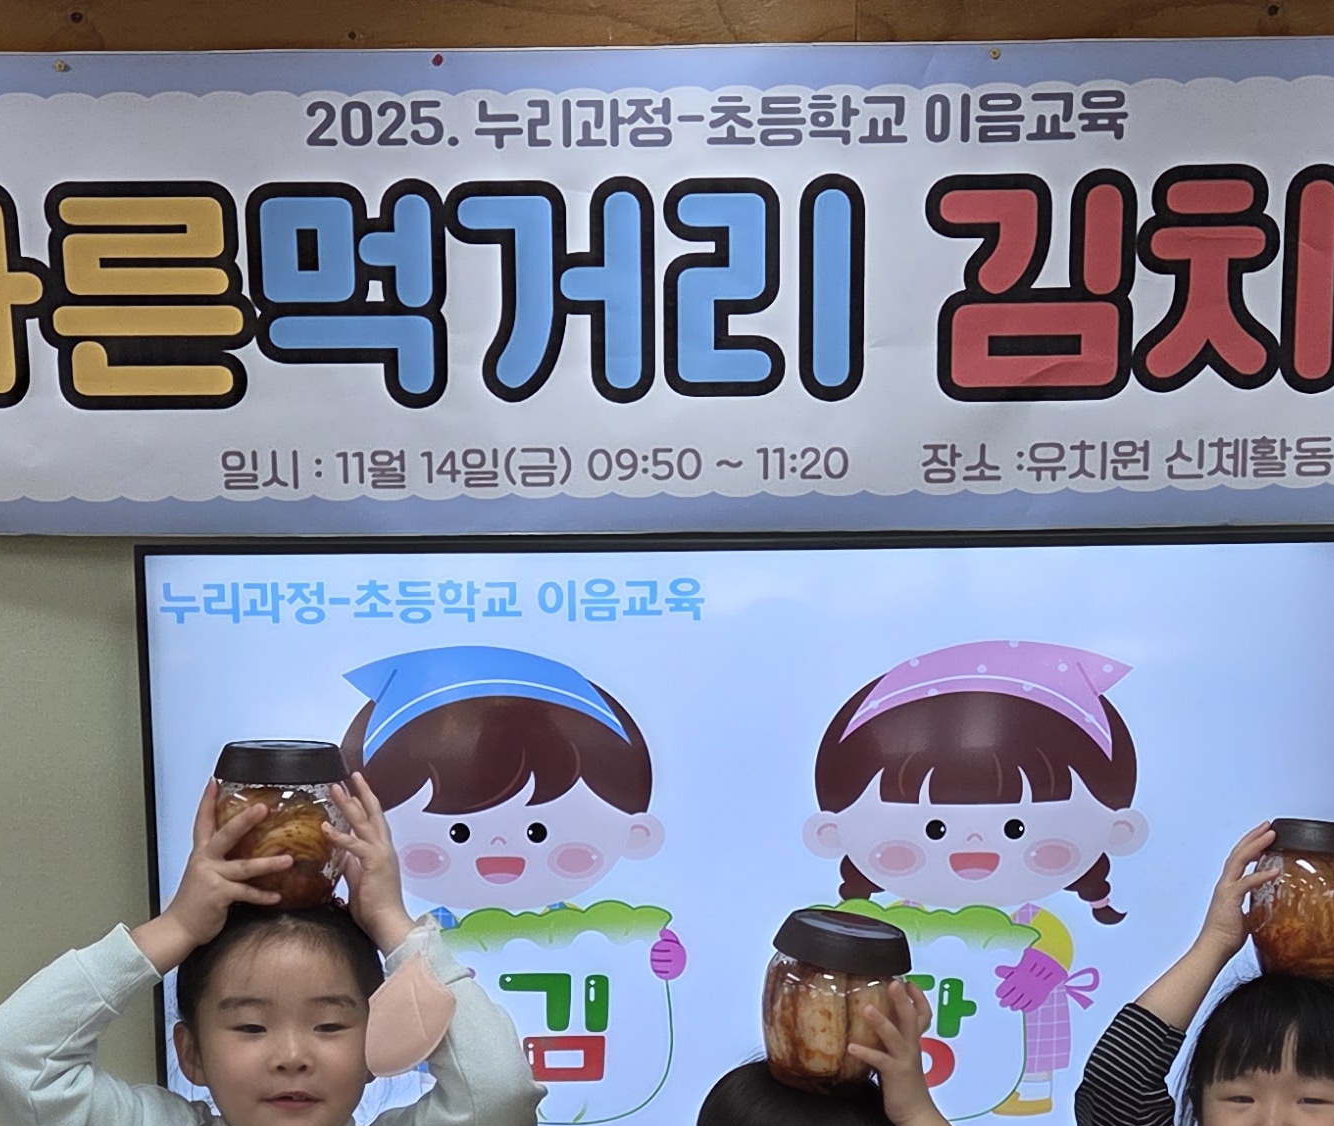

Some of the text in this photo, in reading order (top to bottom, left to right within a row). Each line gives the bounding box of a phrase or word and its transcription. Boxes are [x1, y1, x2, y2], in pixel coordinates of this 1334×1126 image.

[305, 89, 1128, 149] 2025. 누리과정-초등학교 이음교육
[222, 450, 298, 490] 일시
[336, 450, 406, 489] 11월
[421, 447, 571, 488] 14일(금)
[588, 448, 701, 481] 09:50
[757, 447, 848, 480] 11:20
[922, 443, 1001, 483] 장소
[160, 578, 704, 624] 누리과정-초등학교 이음교육
[499, 973, 610, 1081] 김
